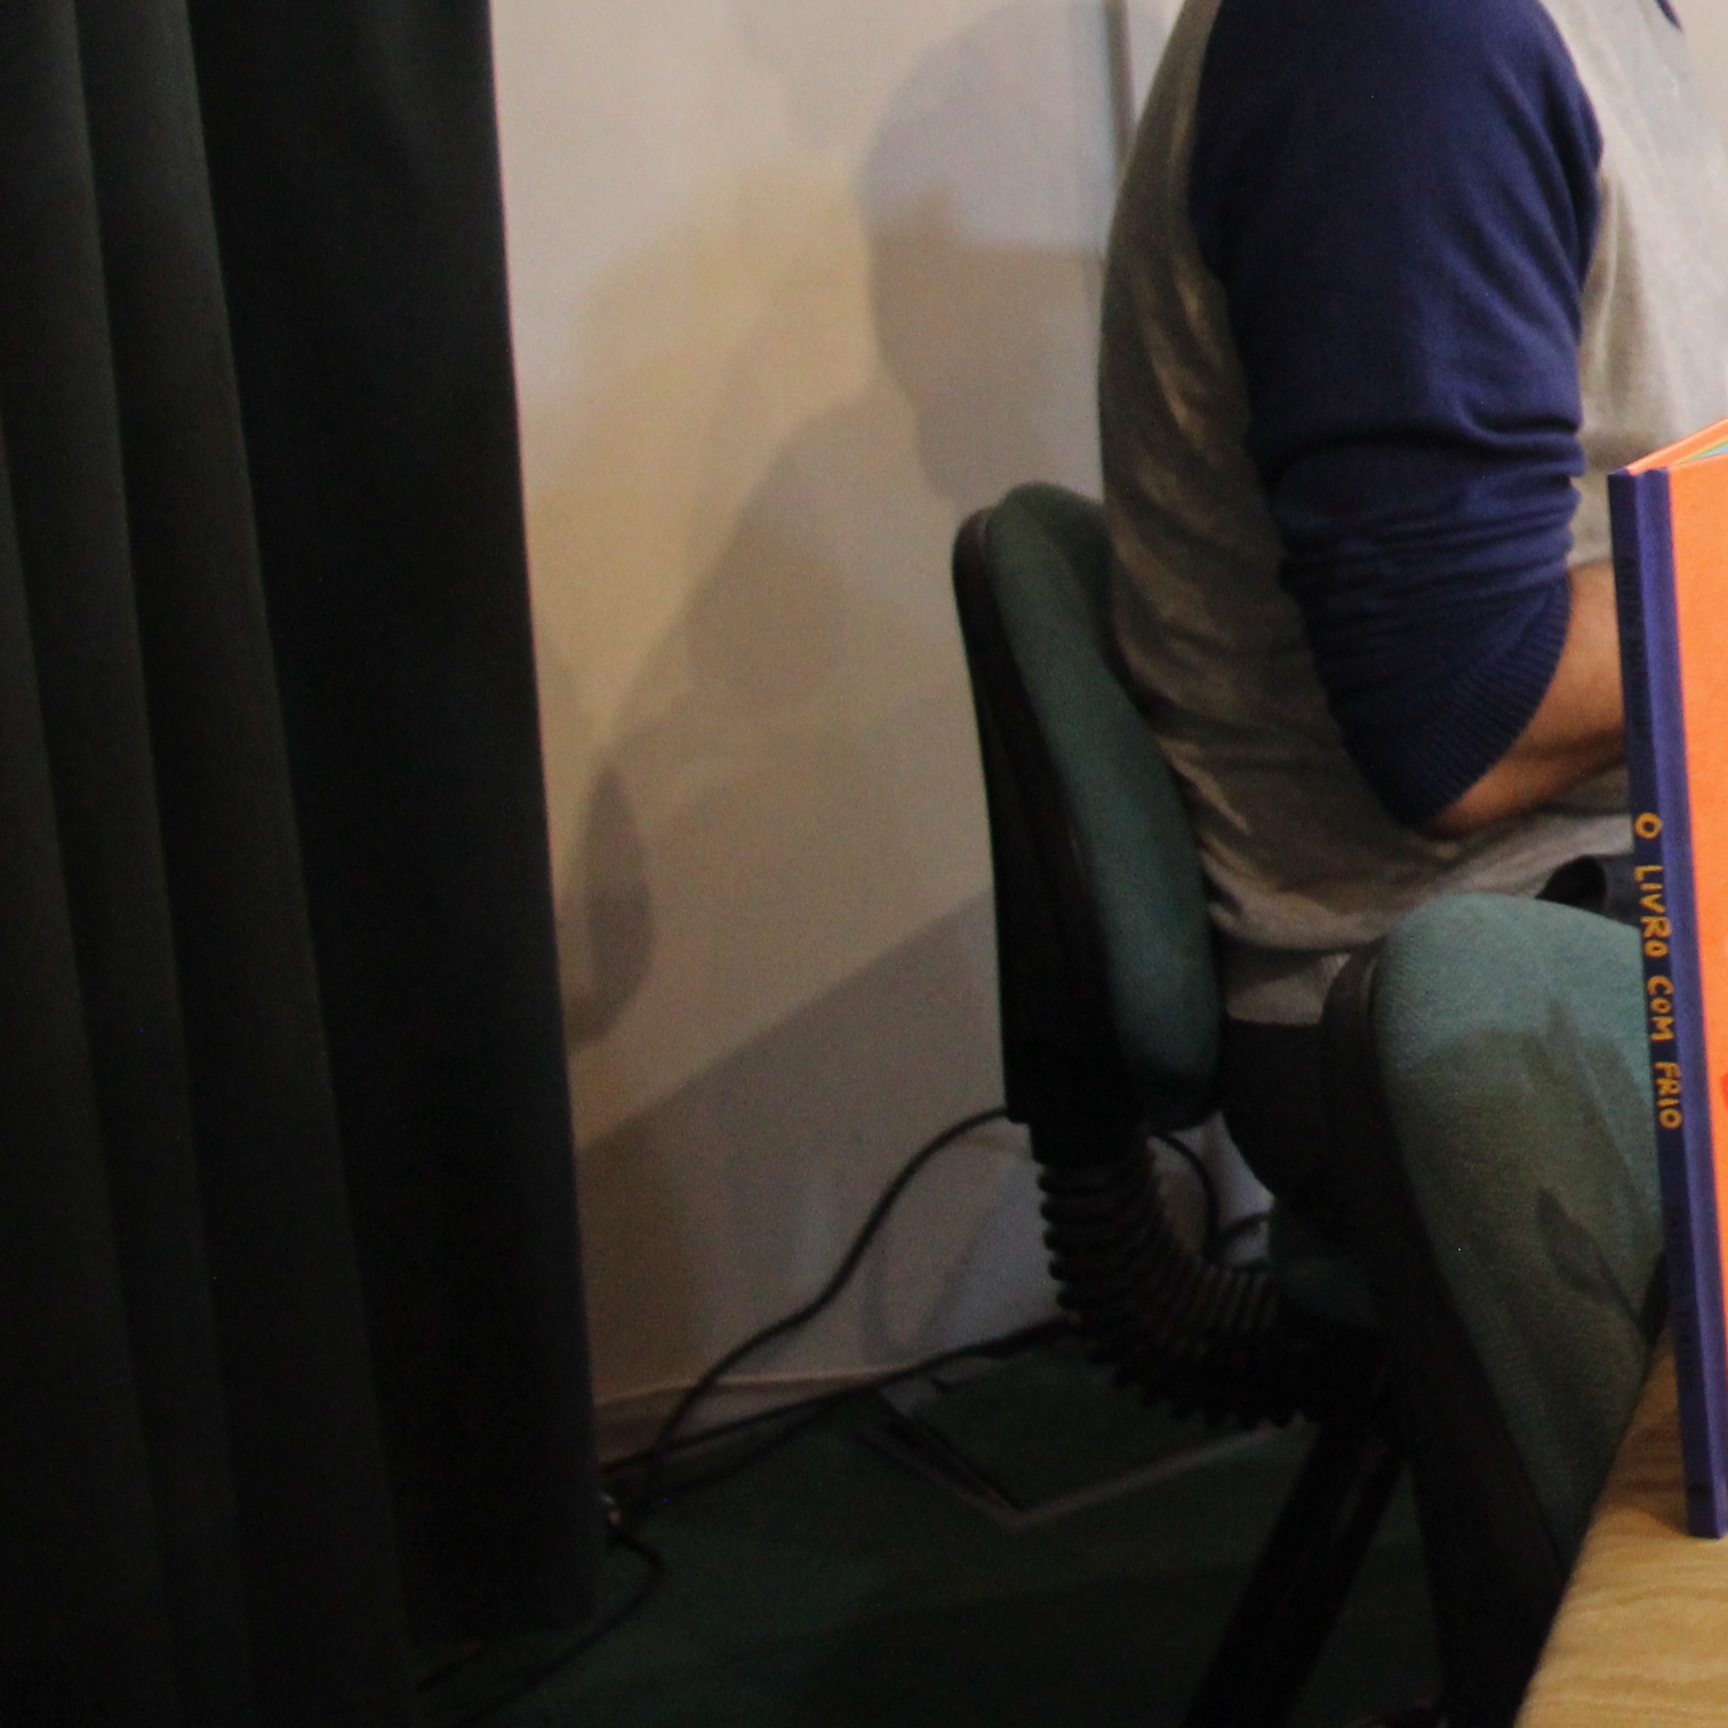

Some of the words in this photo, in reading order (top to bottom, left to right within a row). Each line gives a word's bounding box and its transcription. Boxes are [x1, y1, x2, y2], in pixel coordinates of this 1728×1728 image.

[1634, 812, 1663, 840] O
[1633, 865, 1673, 958] LIVRO
[1646, 975, 1675, 1042] COM
[1654, 1061, 1684, 1129] FRIO
